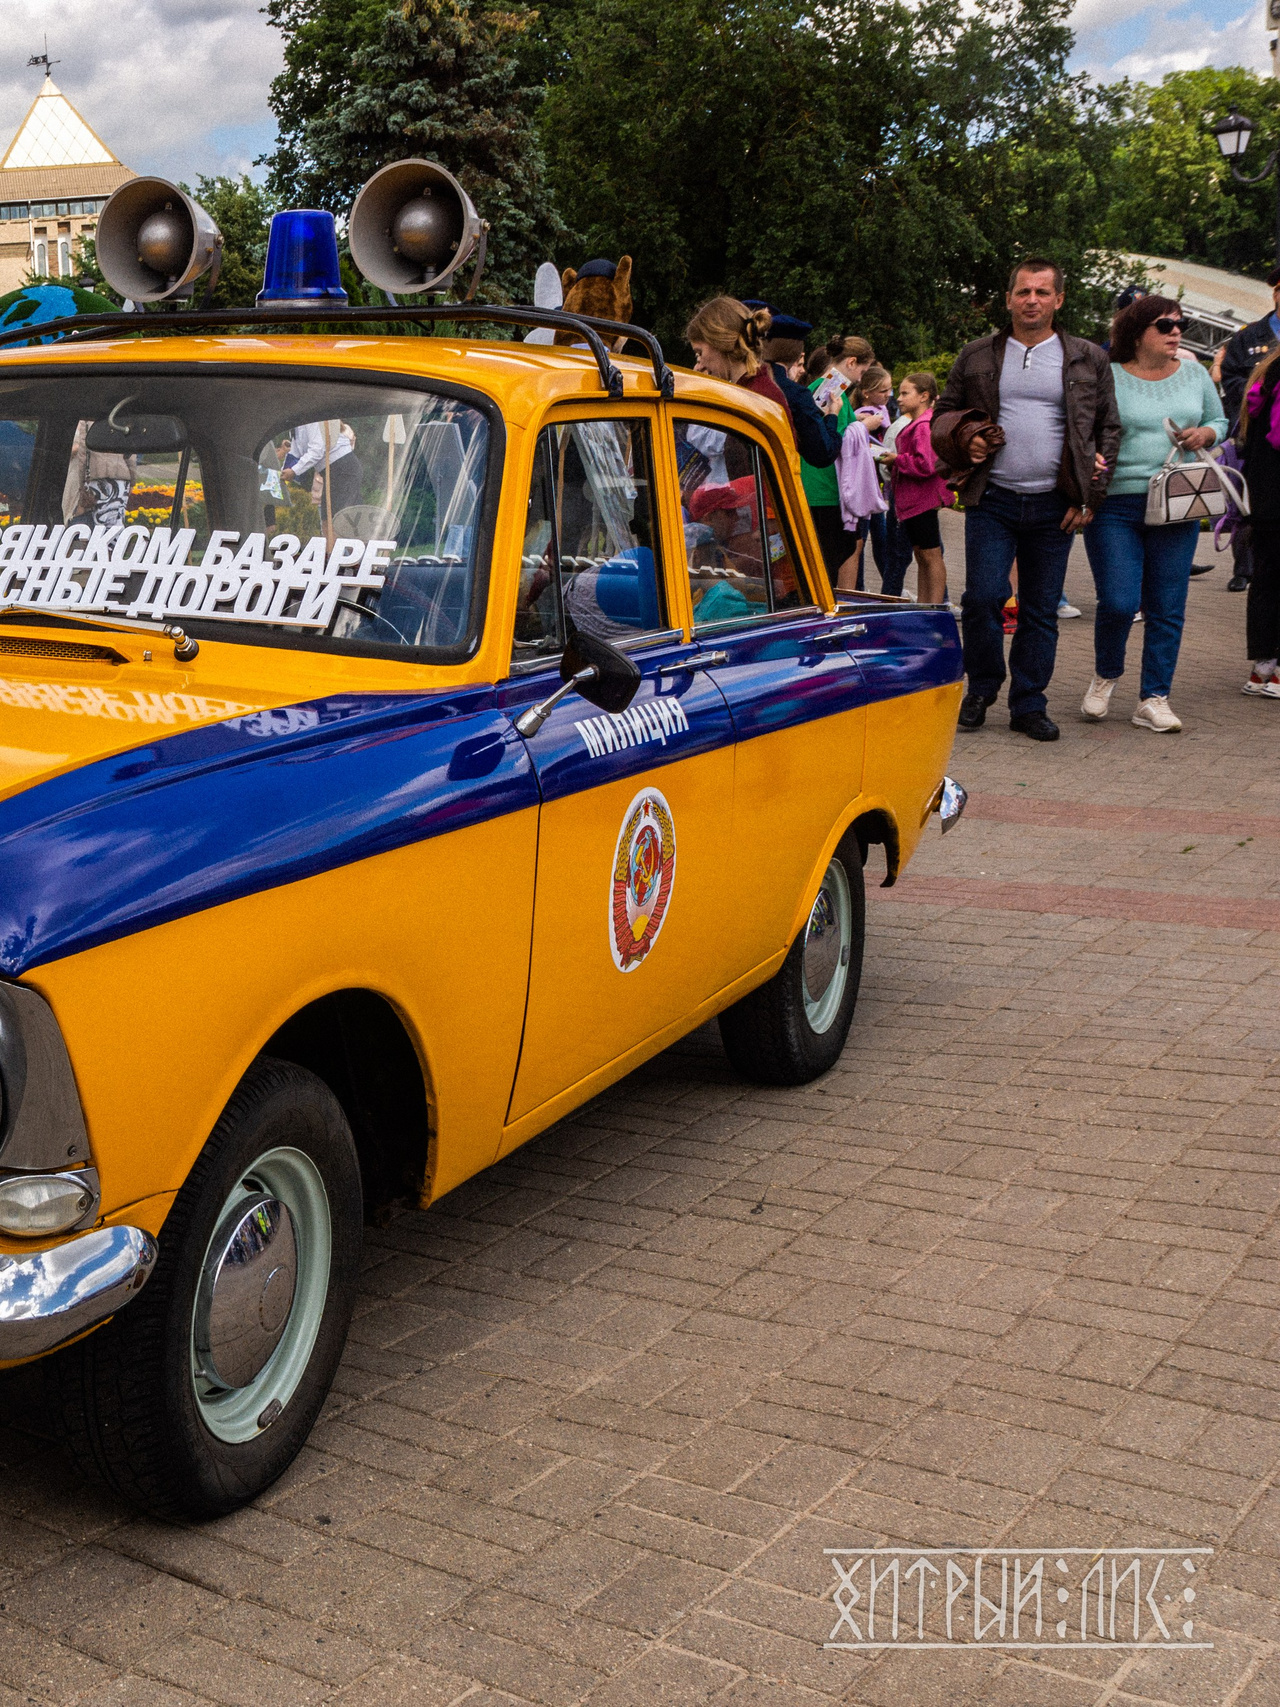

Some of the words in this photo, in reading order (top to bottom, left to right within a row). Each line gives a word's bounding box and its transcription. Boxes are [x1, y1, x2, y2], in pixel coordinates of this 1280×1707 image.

[201, 529, 397, 579] БАЗАРЕ
[125, 568, 342, 626] ДОРОГИ
[574, 697, 689, 758] МИЛИЦИЯ
